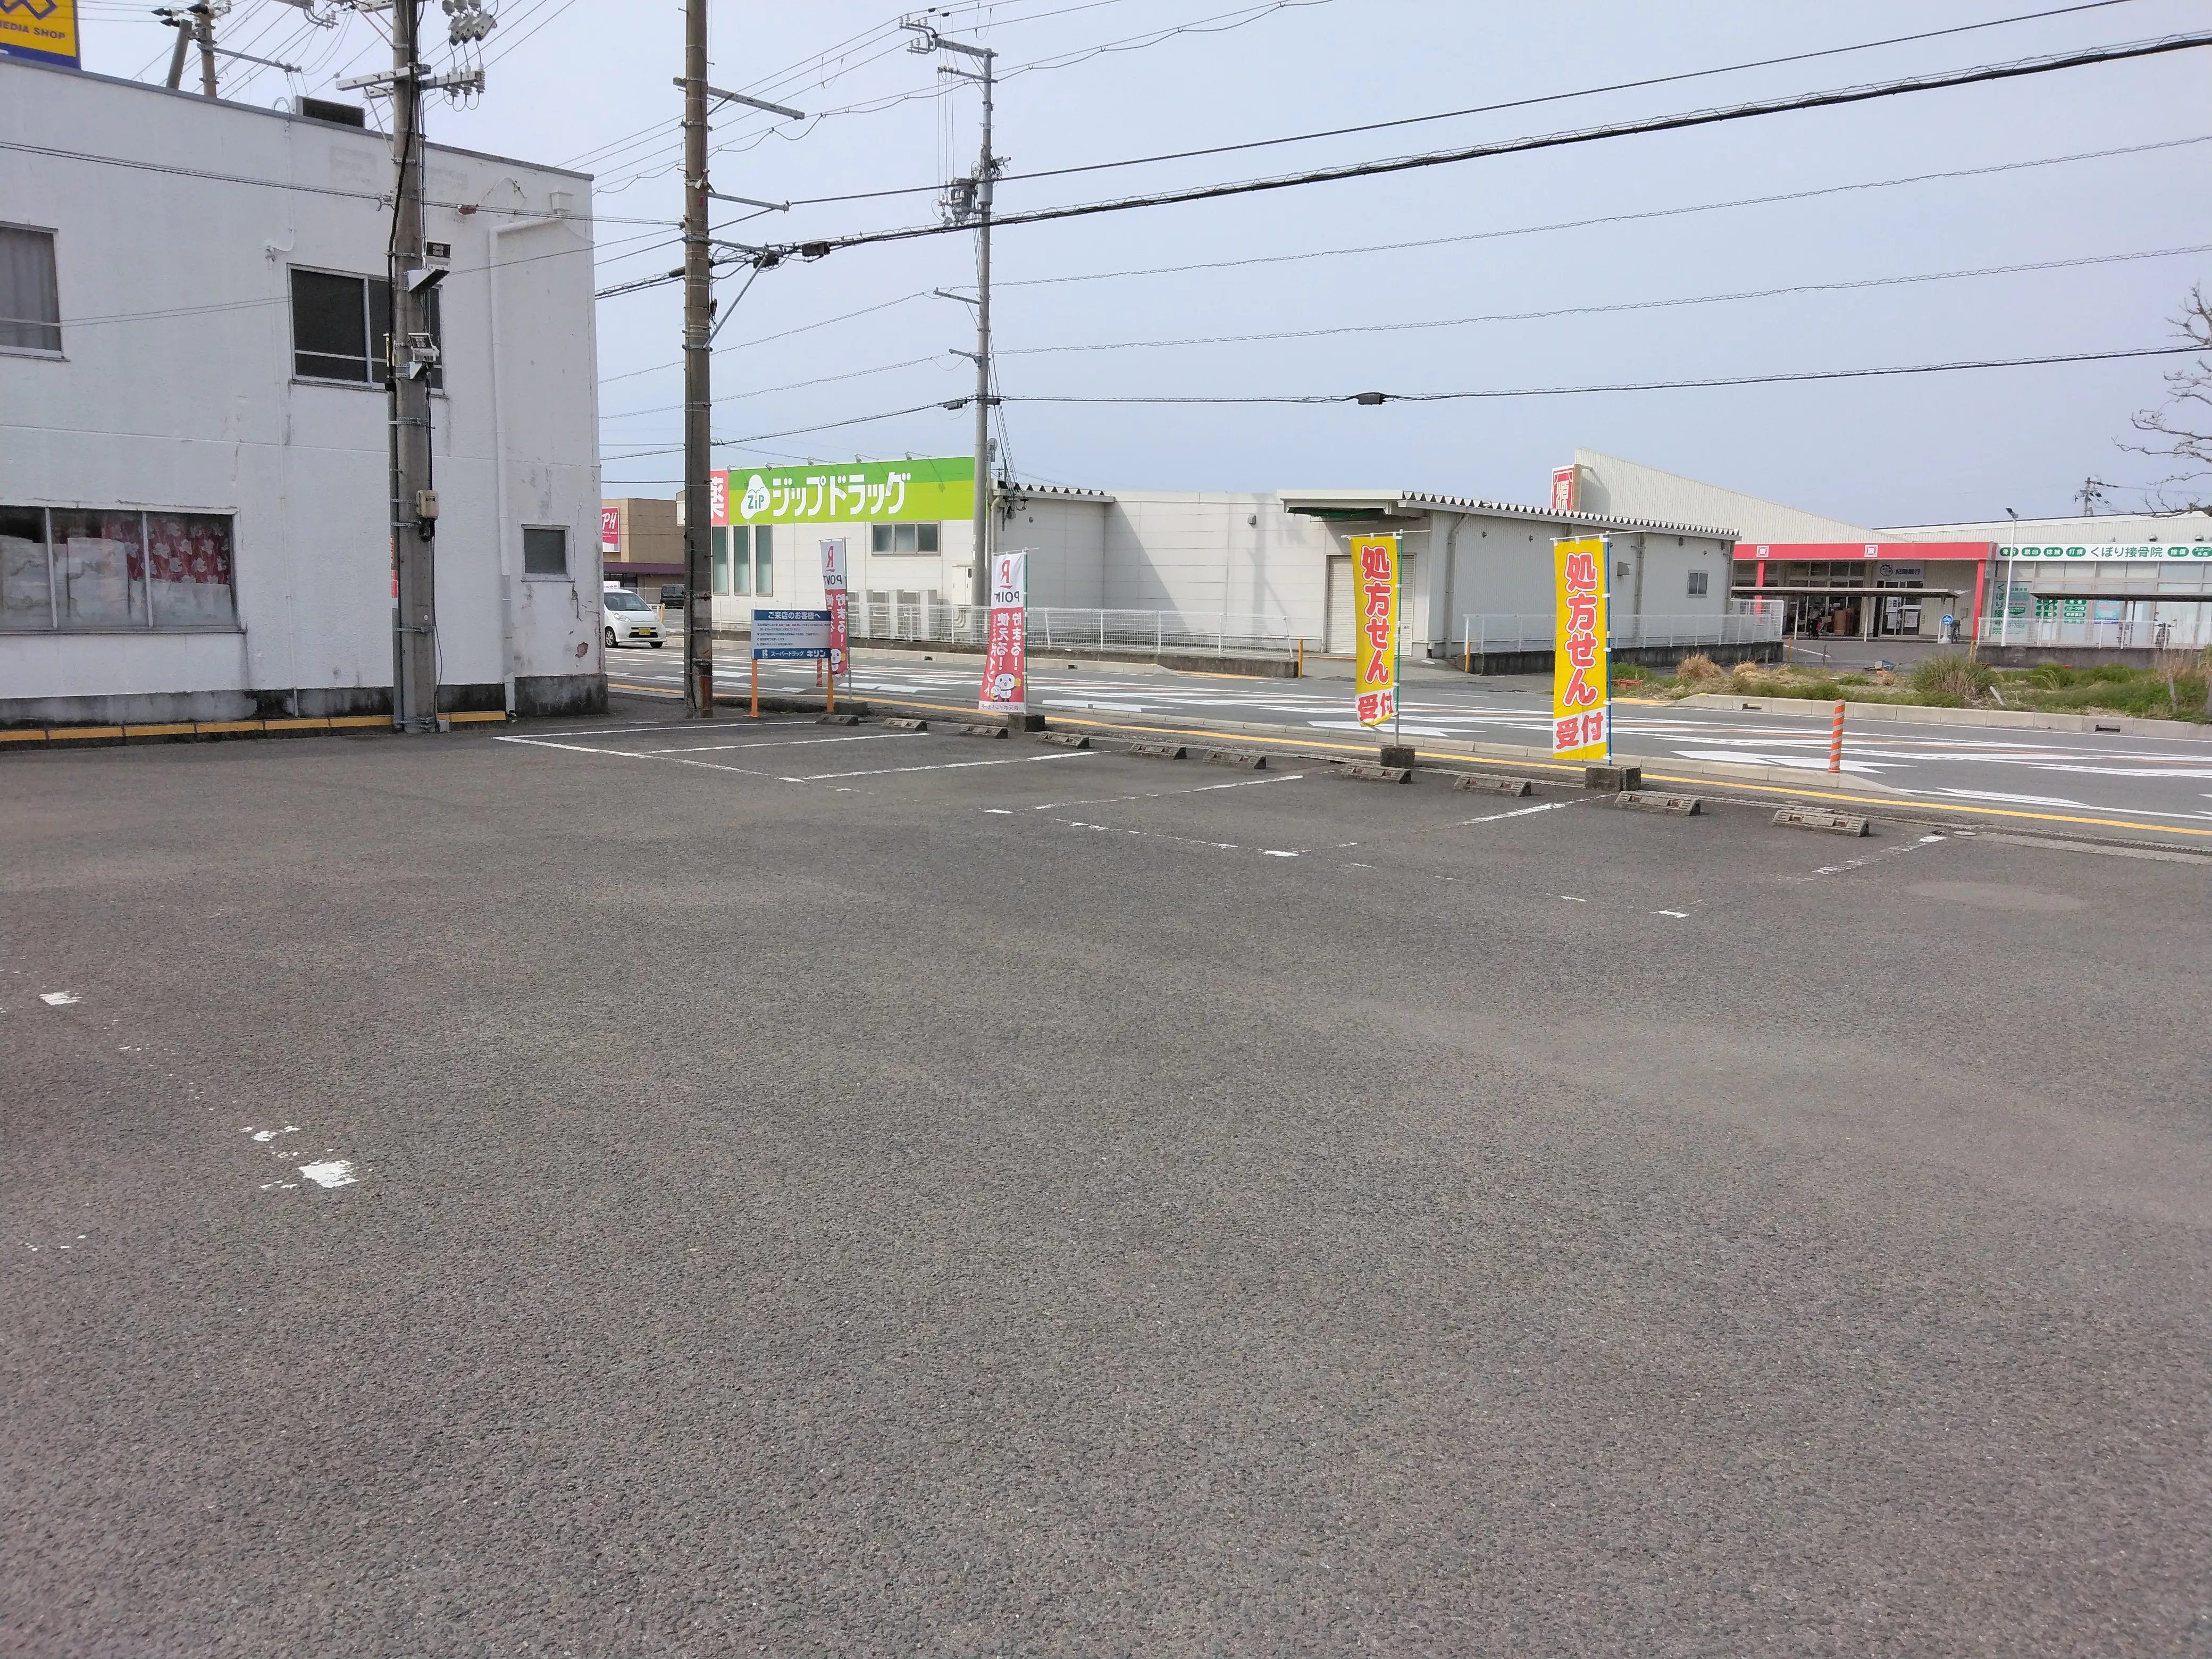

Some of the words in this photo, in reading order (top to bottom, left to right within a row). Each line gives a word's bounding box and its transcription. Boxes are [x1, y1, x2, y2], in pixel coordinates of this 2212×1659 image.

[33, 27, 65, 39] SHOP
[773, 472, 911, 517] ジップドラッグ
[1361, 545, 1392, 684] 処方せん
[1563, 552, 1598, 707] 処方せん
[1358, 691, 1394, 722] 受付
[1556, 711, 1604, 750] 受付
